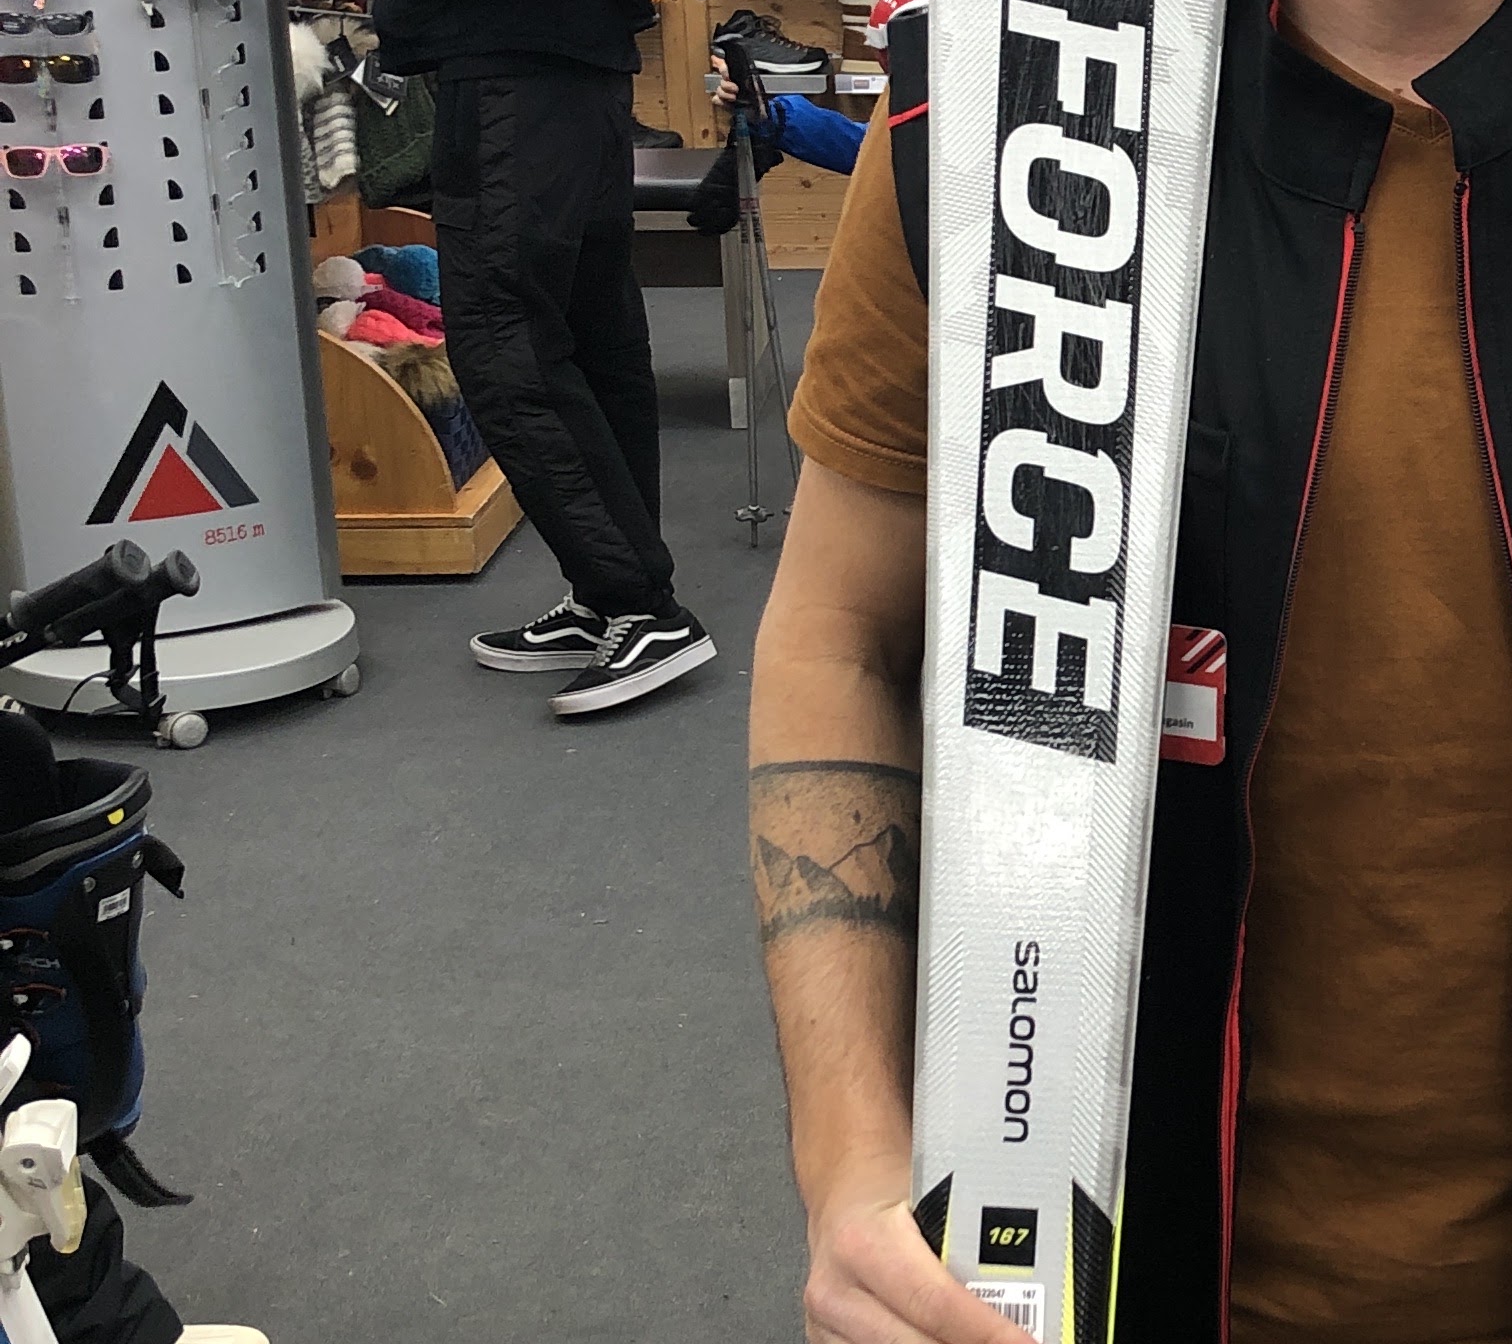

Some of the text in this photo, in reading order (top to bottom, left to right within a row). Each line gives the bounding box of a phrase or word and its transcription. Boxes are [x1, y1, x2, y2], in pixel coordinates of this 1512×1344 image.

[204, 522, 265, 546] 8516 m
[1161, 716, 1195, 730] gasin
[1003, 940, 1040, 1144] salomon
[989, 1226, 1030, 1246] 167
